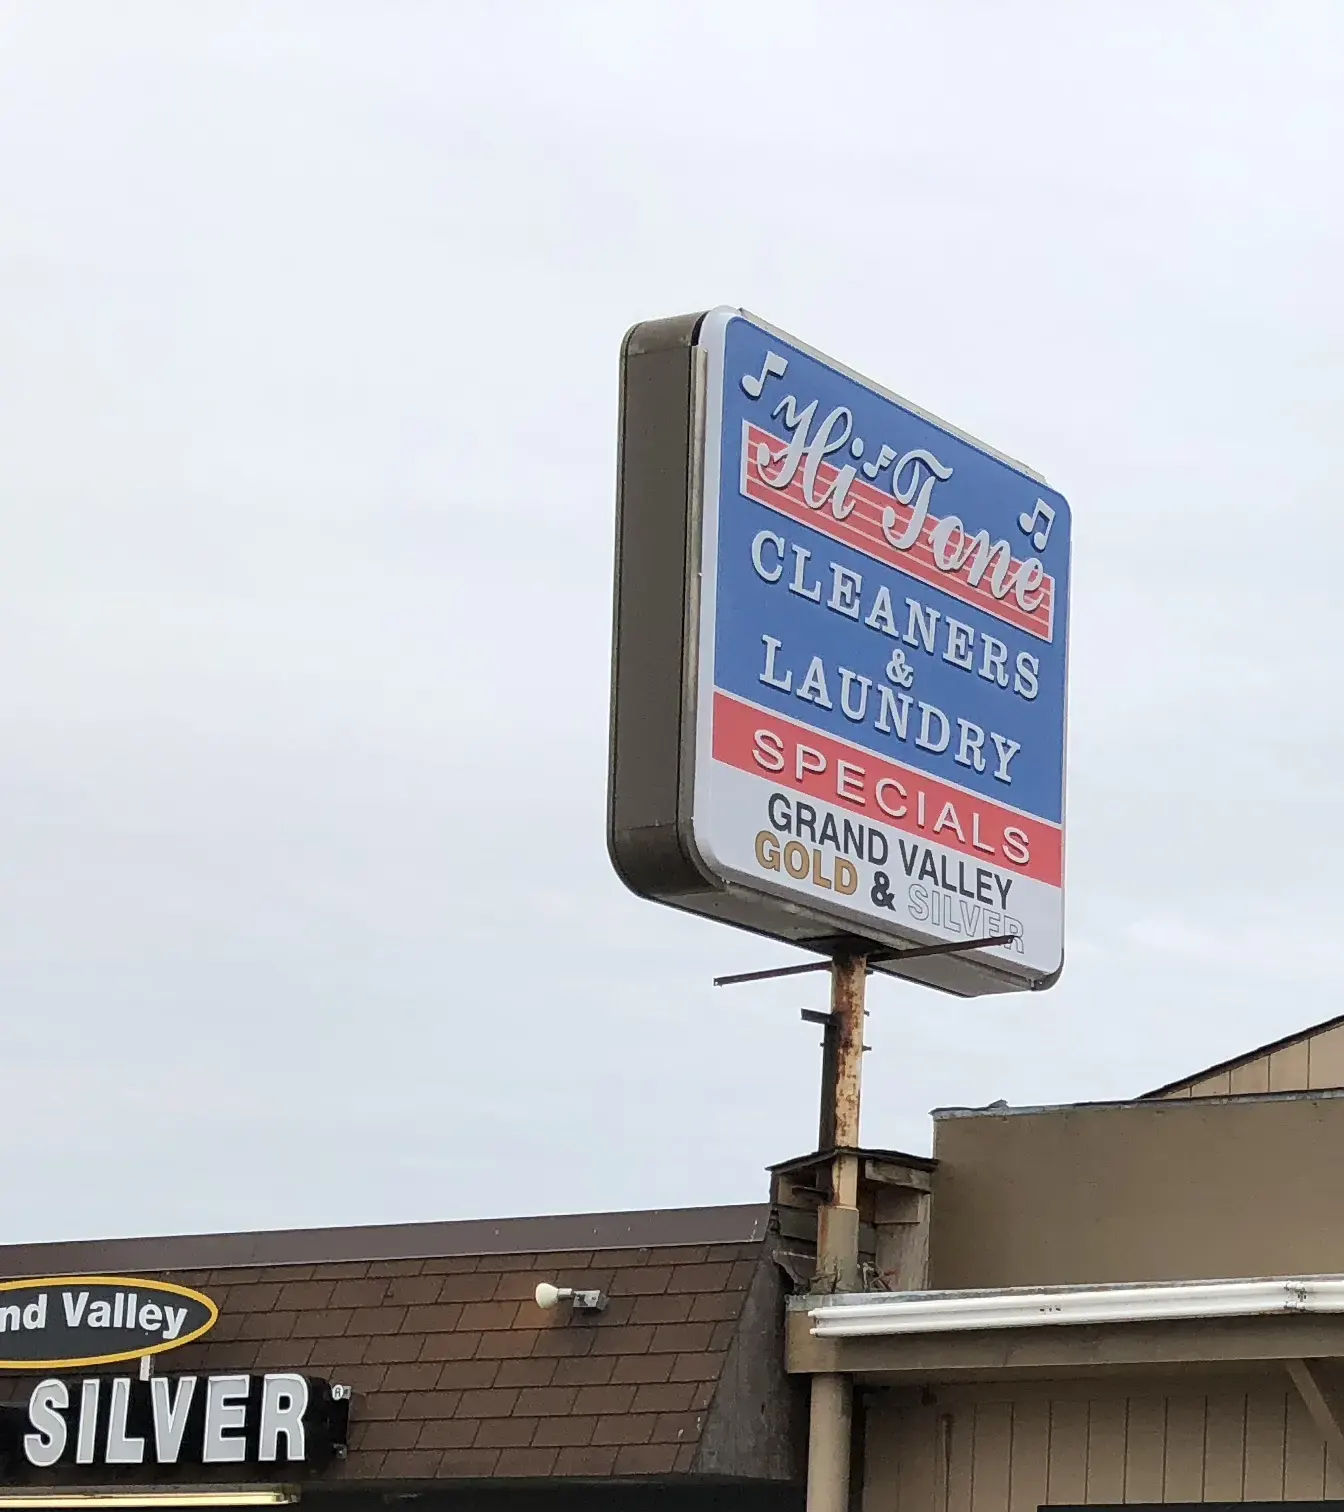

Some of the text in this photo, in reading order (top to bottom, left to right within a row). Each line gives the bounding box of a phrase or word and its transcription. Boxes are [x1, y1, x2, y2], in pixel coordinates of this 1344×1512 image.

[757, 394, 1046, 612] Hi Tone
[751, 530, 1040, 700] CLEANERS
[886, 648, 914, 688] &
[759, 634, 1020, 784] LAUNDRY
[752, 728, 1030, 864] SPECIALS
[768, 792, 1012, 910] GRAND VALLEY
[754, 830, 1025, 954] GOLD & SILVER
[62, 1291, 188, 1339] Valley
[24, 1373, 310, 1467] SILVER
